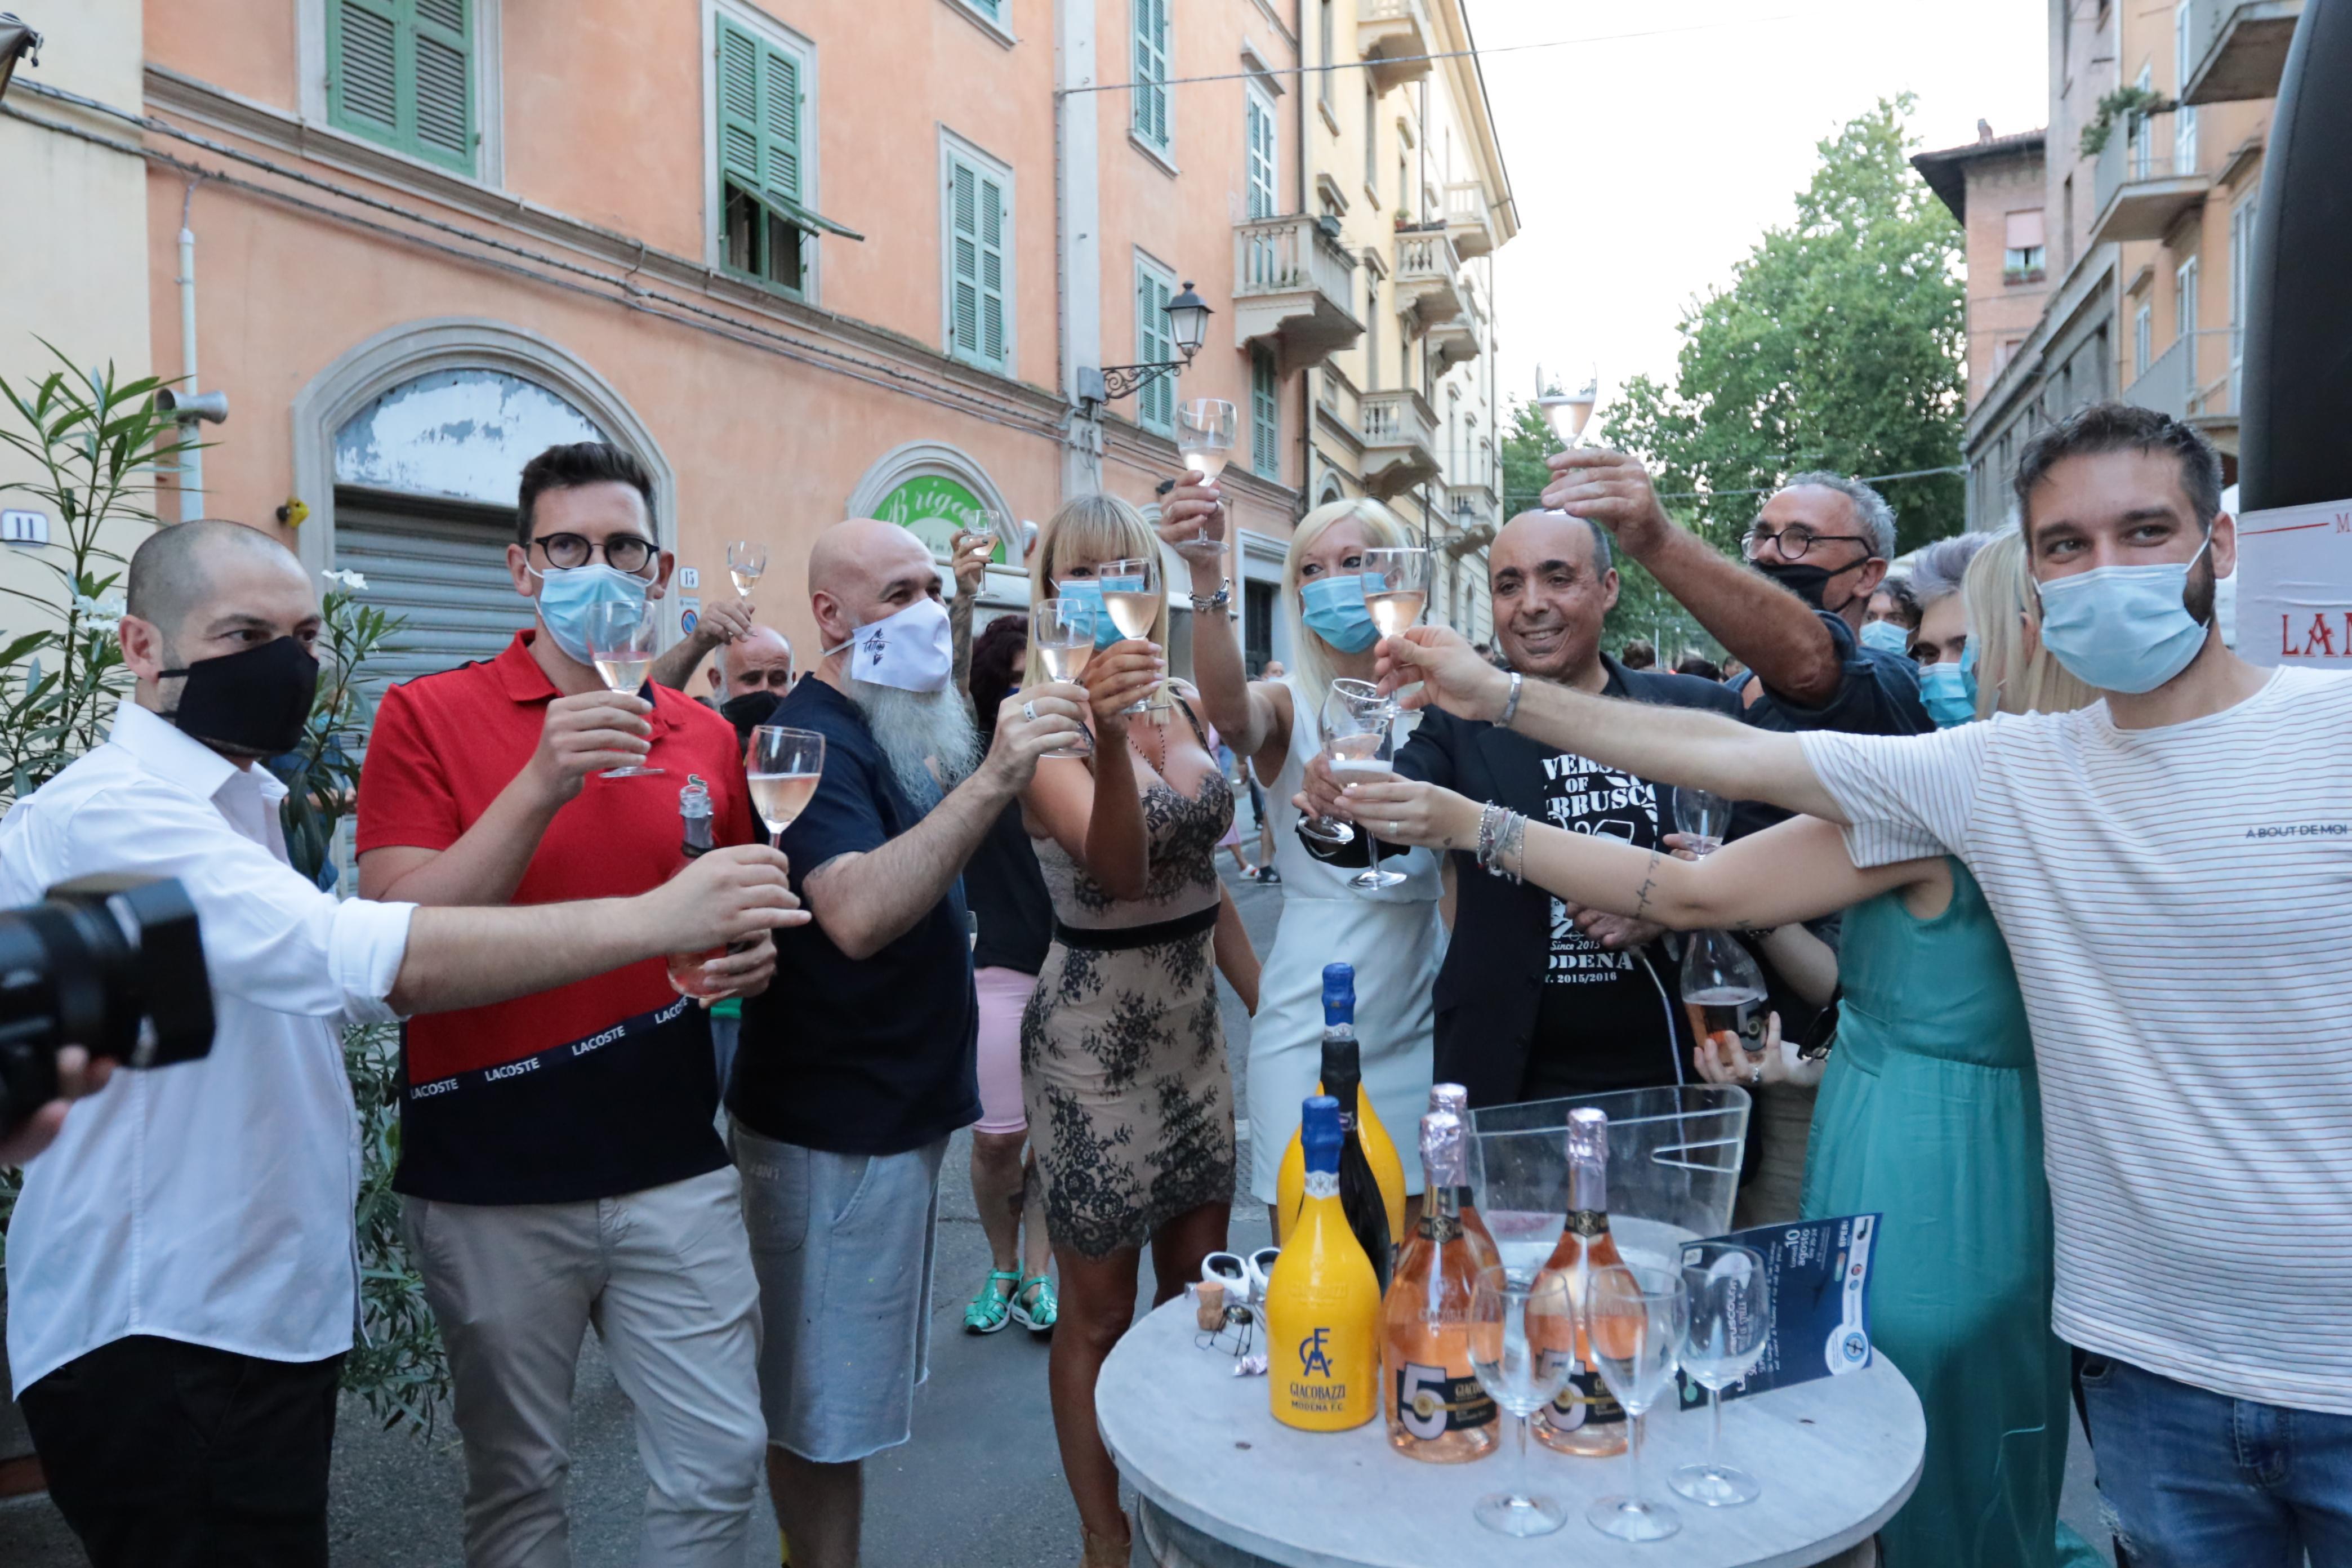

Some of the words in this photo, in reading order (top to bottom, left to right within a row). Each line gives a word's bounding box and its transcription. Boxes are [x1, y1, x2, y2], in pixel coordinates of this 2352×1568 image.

[15, 516, 34, 539] 11
[685, 571, 694, 586] 15
[1565, 776, 1589, 793] OF
[1550, 941, 1574, 951] Since
[1576, 941, 1600, 950] 2015
[1557, 972, 1617, 983] 2015/2016
[571, 1026, 625, 1056] LACOSTE
[484, 1058, 540, 1082] LACOSTE
[410, 1079, 459, 1099] LACOSTE
[1784, 1229, 1801, 1248] 10
[1798, 1228, 1811, 1266] agosto
[1290, 1382, 1346, 1400] GIACOBAZZI
[1401, 1361, 1447, 1440] 5
[1291, 1401, 1328, 1411] MODENA
